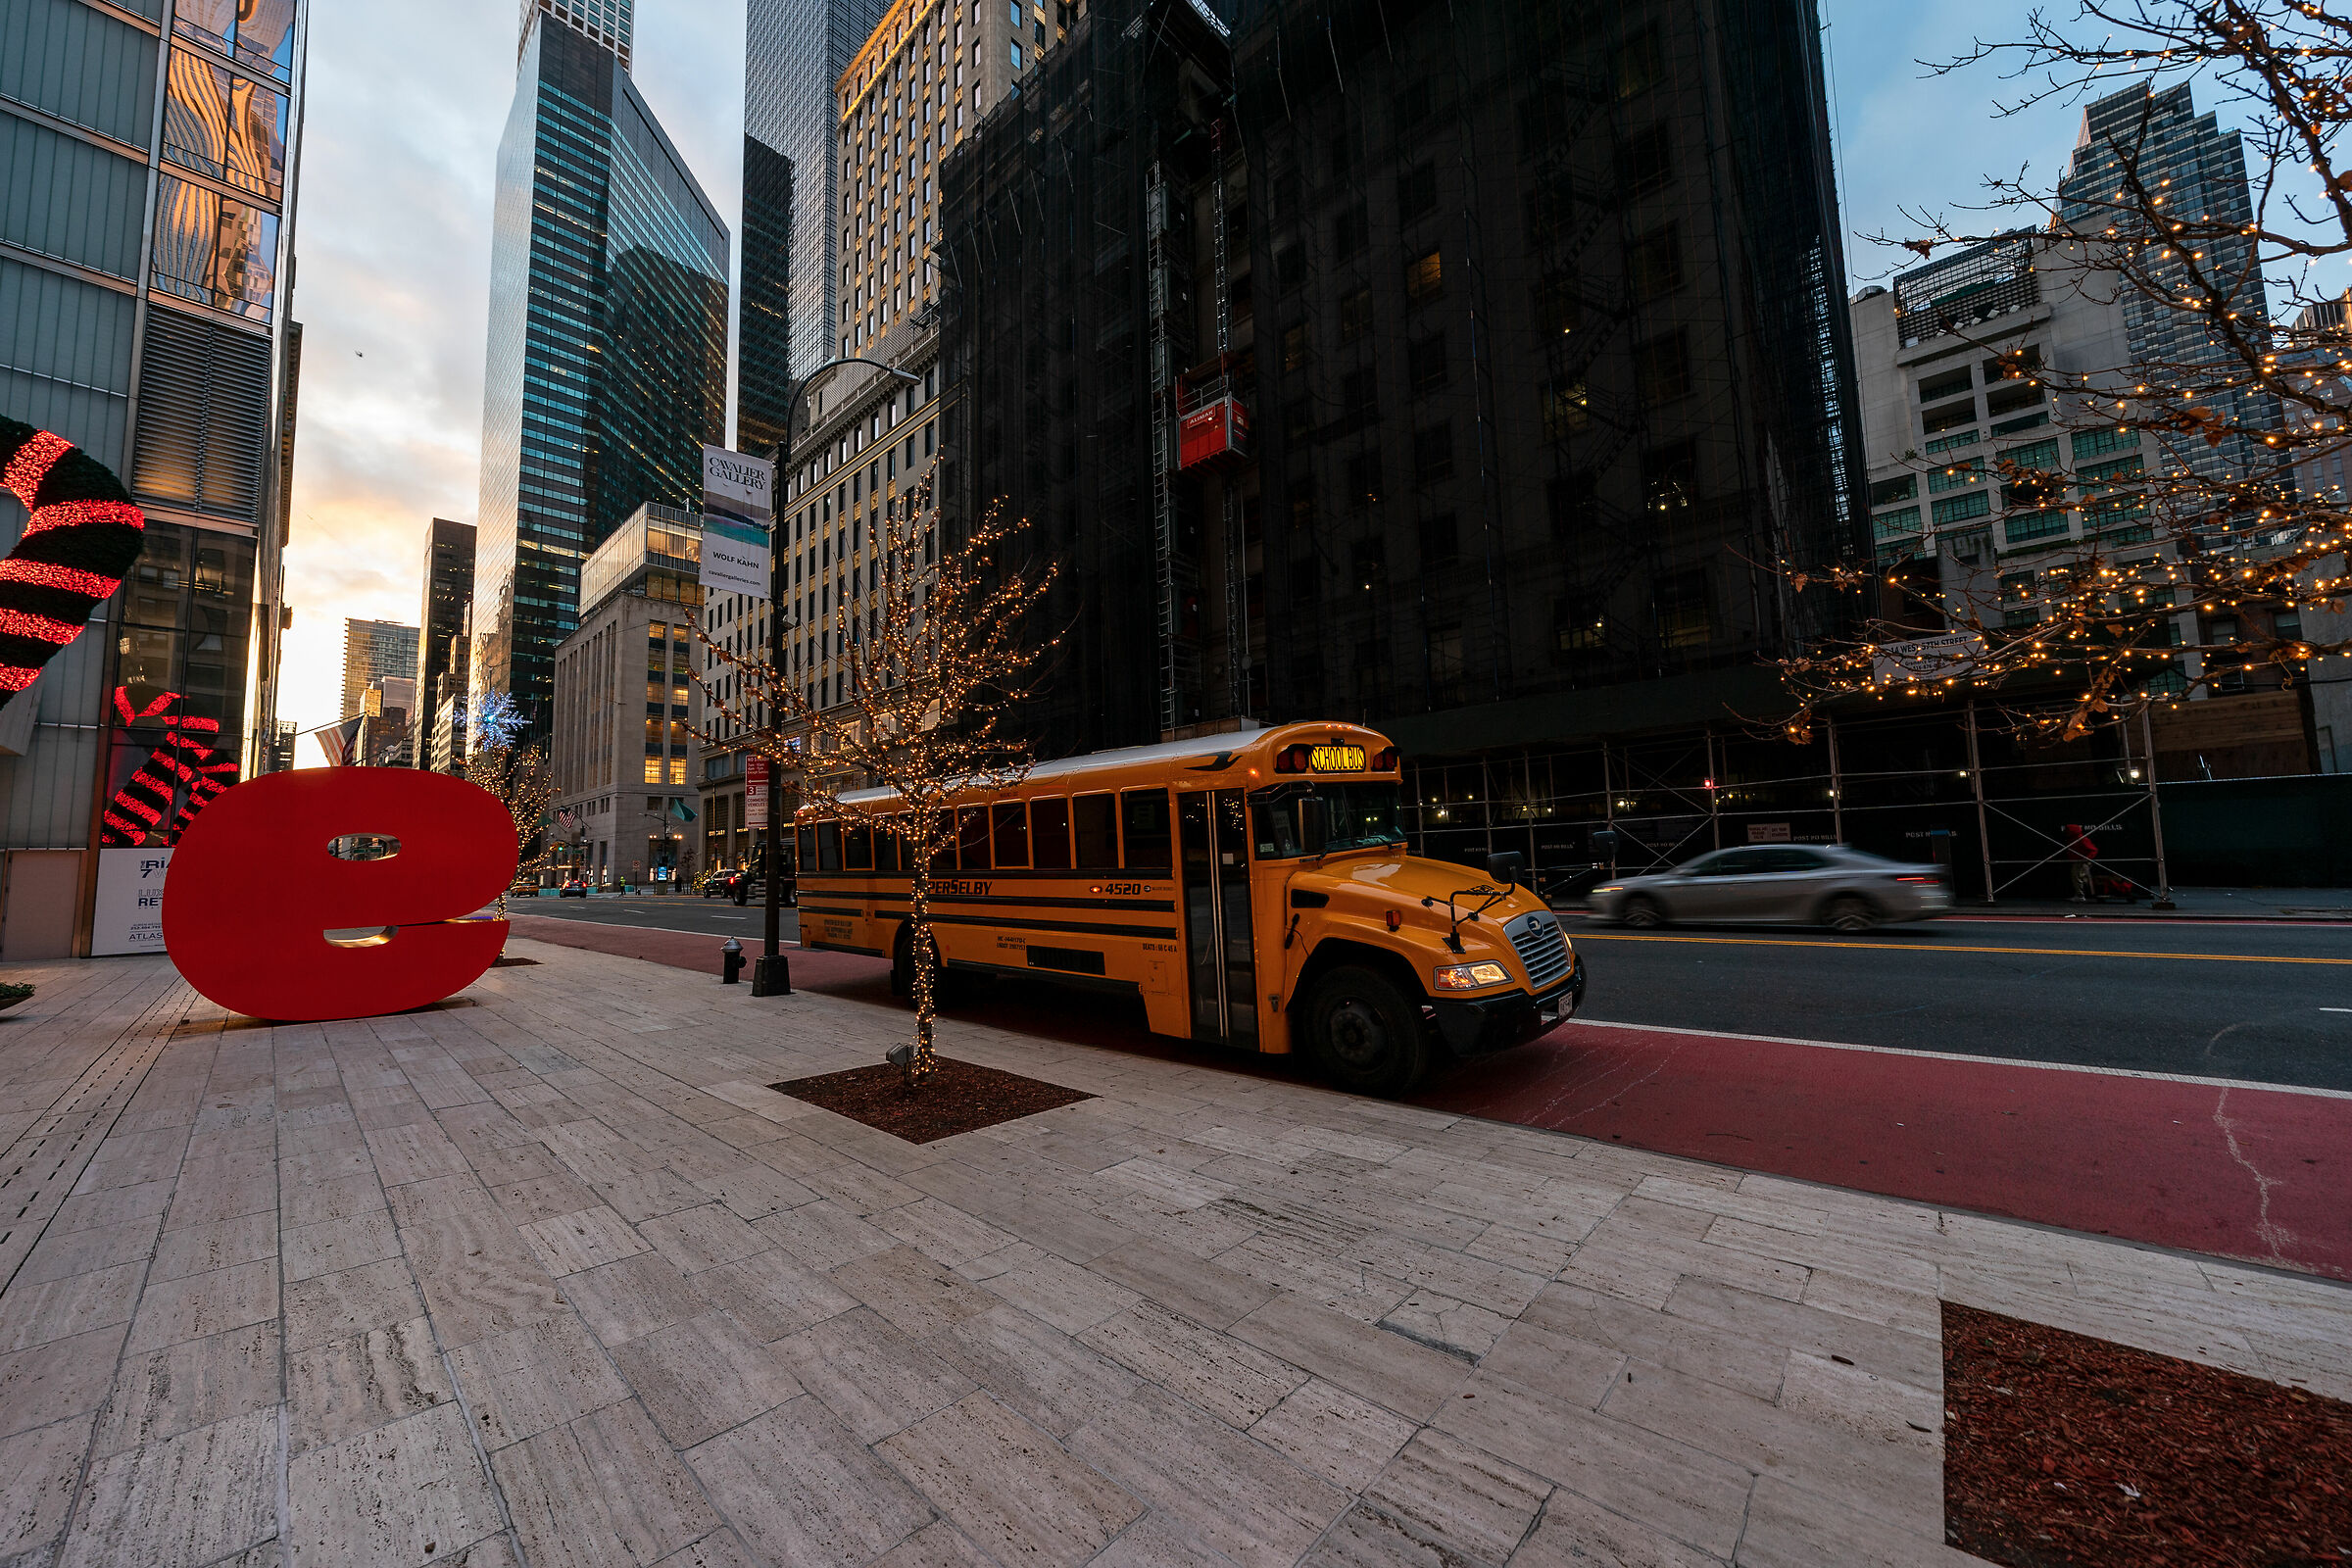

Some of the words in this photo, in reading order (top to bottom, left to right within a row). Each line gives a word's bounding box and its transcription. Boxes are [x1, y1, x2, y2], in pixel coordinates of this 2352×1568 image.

[1190, 410, 1213, 424] ALIMAK
[709, 457, 765, 481] CAVALIER
[710, 466, 766, 490] GALLERY
[712, 551, 735, 563] WOLF
[737, 558, 760, 569] KAHN
[708, 569, 761, 586] cavaliergalleries.com
[1941, 636, 1968, 646] STREET
[1311, 747, 1348, 770] SCHOOL
[1348, 747, 1365, 769] BUS
[748, 786, 755, 795] 3
[1104, 883, 1142, 896] 4520
[138, 897, 164, 906] RE
[128, 932, 163, 941] ATLAS
